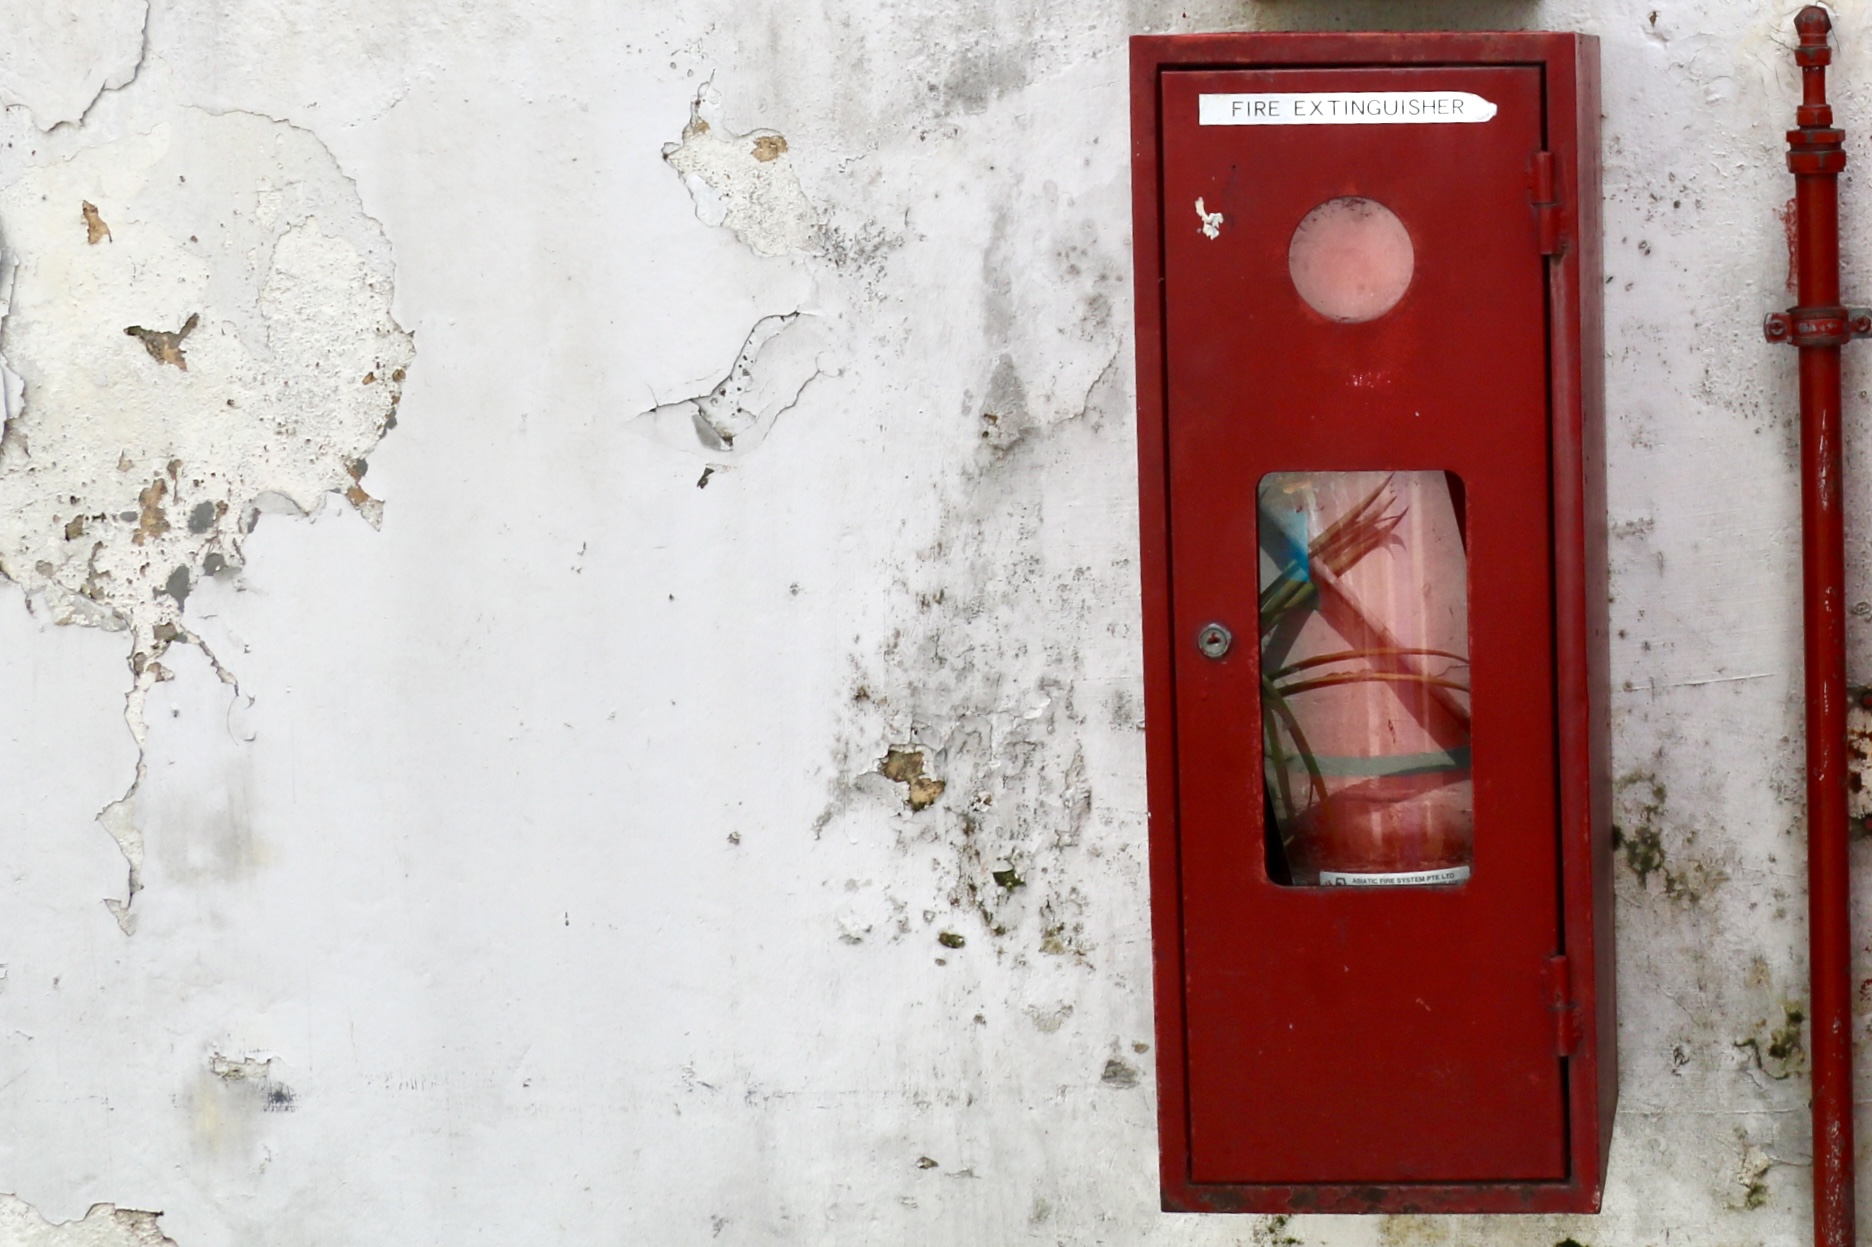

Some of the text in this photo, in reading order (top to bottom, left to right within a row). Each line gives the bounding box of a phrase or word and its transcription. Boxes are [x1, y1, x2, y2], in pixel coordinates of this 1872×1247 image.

[1231, 98, 1465, 117] FIRE EXTINGUISHER
[1379, 877, 1395, 885] FIRE
[1396, 876, 1425, 884] SYSTEM
[1426, 874, 1440, 882] PTE
[1441, 872, 1455, 880] LTD
